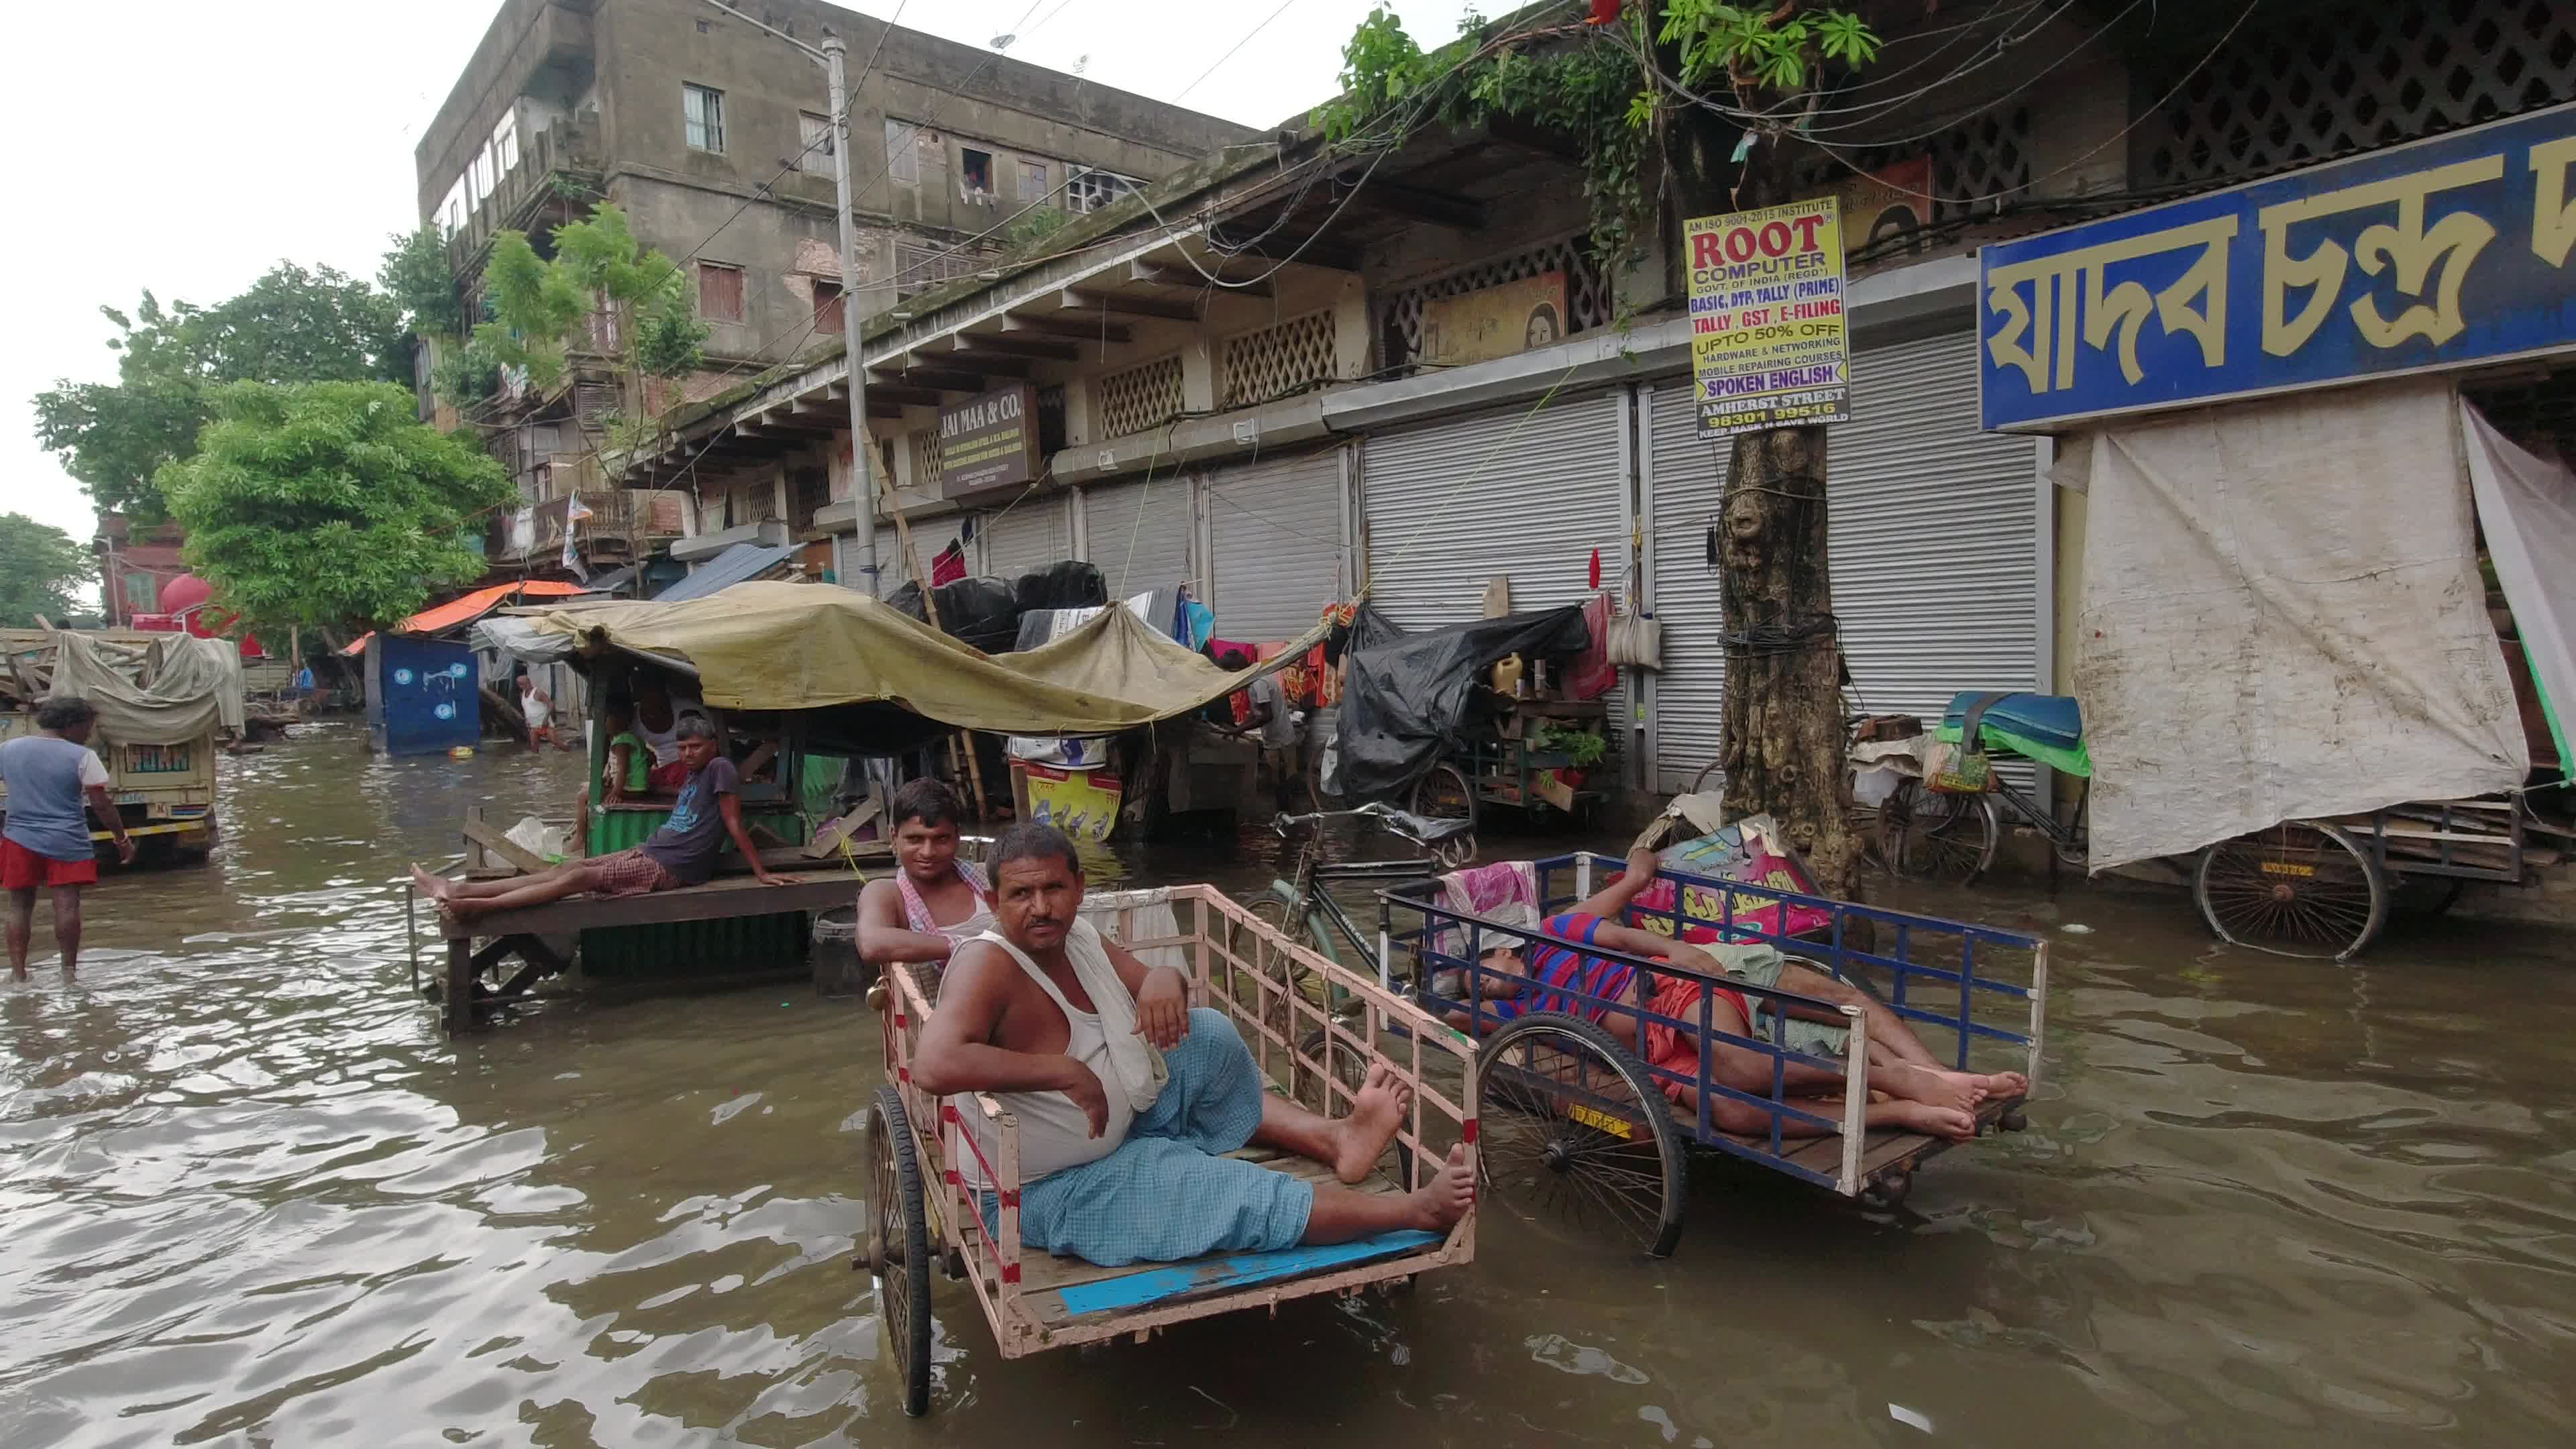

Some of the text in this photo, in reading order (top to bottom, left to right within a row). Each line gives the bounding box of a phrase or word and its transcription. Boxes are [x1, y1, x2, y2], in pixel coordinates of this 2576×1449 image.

[1688, 222, 1702, 231] AN
[1705, 219, 1721, 229] ISO
[1778, 200, 1833, 217] INSTITUTE
[1690, 214, 1825, 269] ROOT
[1693, 252, 1826, 285] COMPUTER
[1696, 283, 1729, 294] GOVT.
[1732, 280, 1746, 289] OF
[1750, 275, 1780, 286] INDIA
[1986, 213, 2239, 394] যাদব
[2259, 153, 2505, 357] চন্দ্র
[1690, 278, 1840, 313] BASIC, DTP, TALLY (PRIME)
[1693, 314, 1731, 334] TALLY
[1741, 309, 1771, 328] GST
[1780, 299, 1841, 323] E-FILING
[1697, 323, 1840, 356] UPTO 50% OFF
[1703, 337, 1841, 364] HARDWARE & NETWORKING
[1699, 350, 1842, 378] MOBILE REPAIRING COURSES
[1707, 365, 1833, 397] SPOKEN ENGLISH
[941, 394, 1021, 439] JAI MAA & CO.
[1701, 388, 1846, 417] AMHERST STREET
[1708, 402, 1836, 428] 98301 99516
[1807, 413, 1849, 425] WORLD
